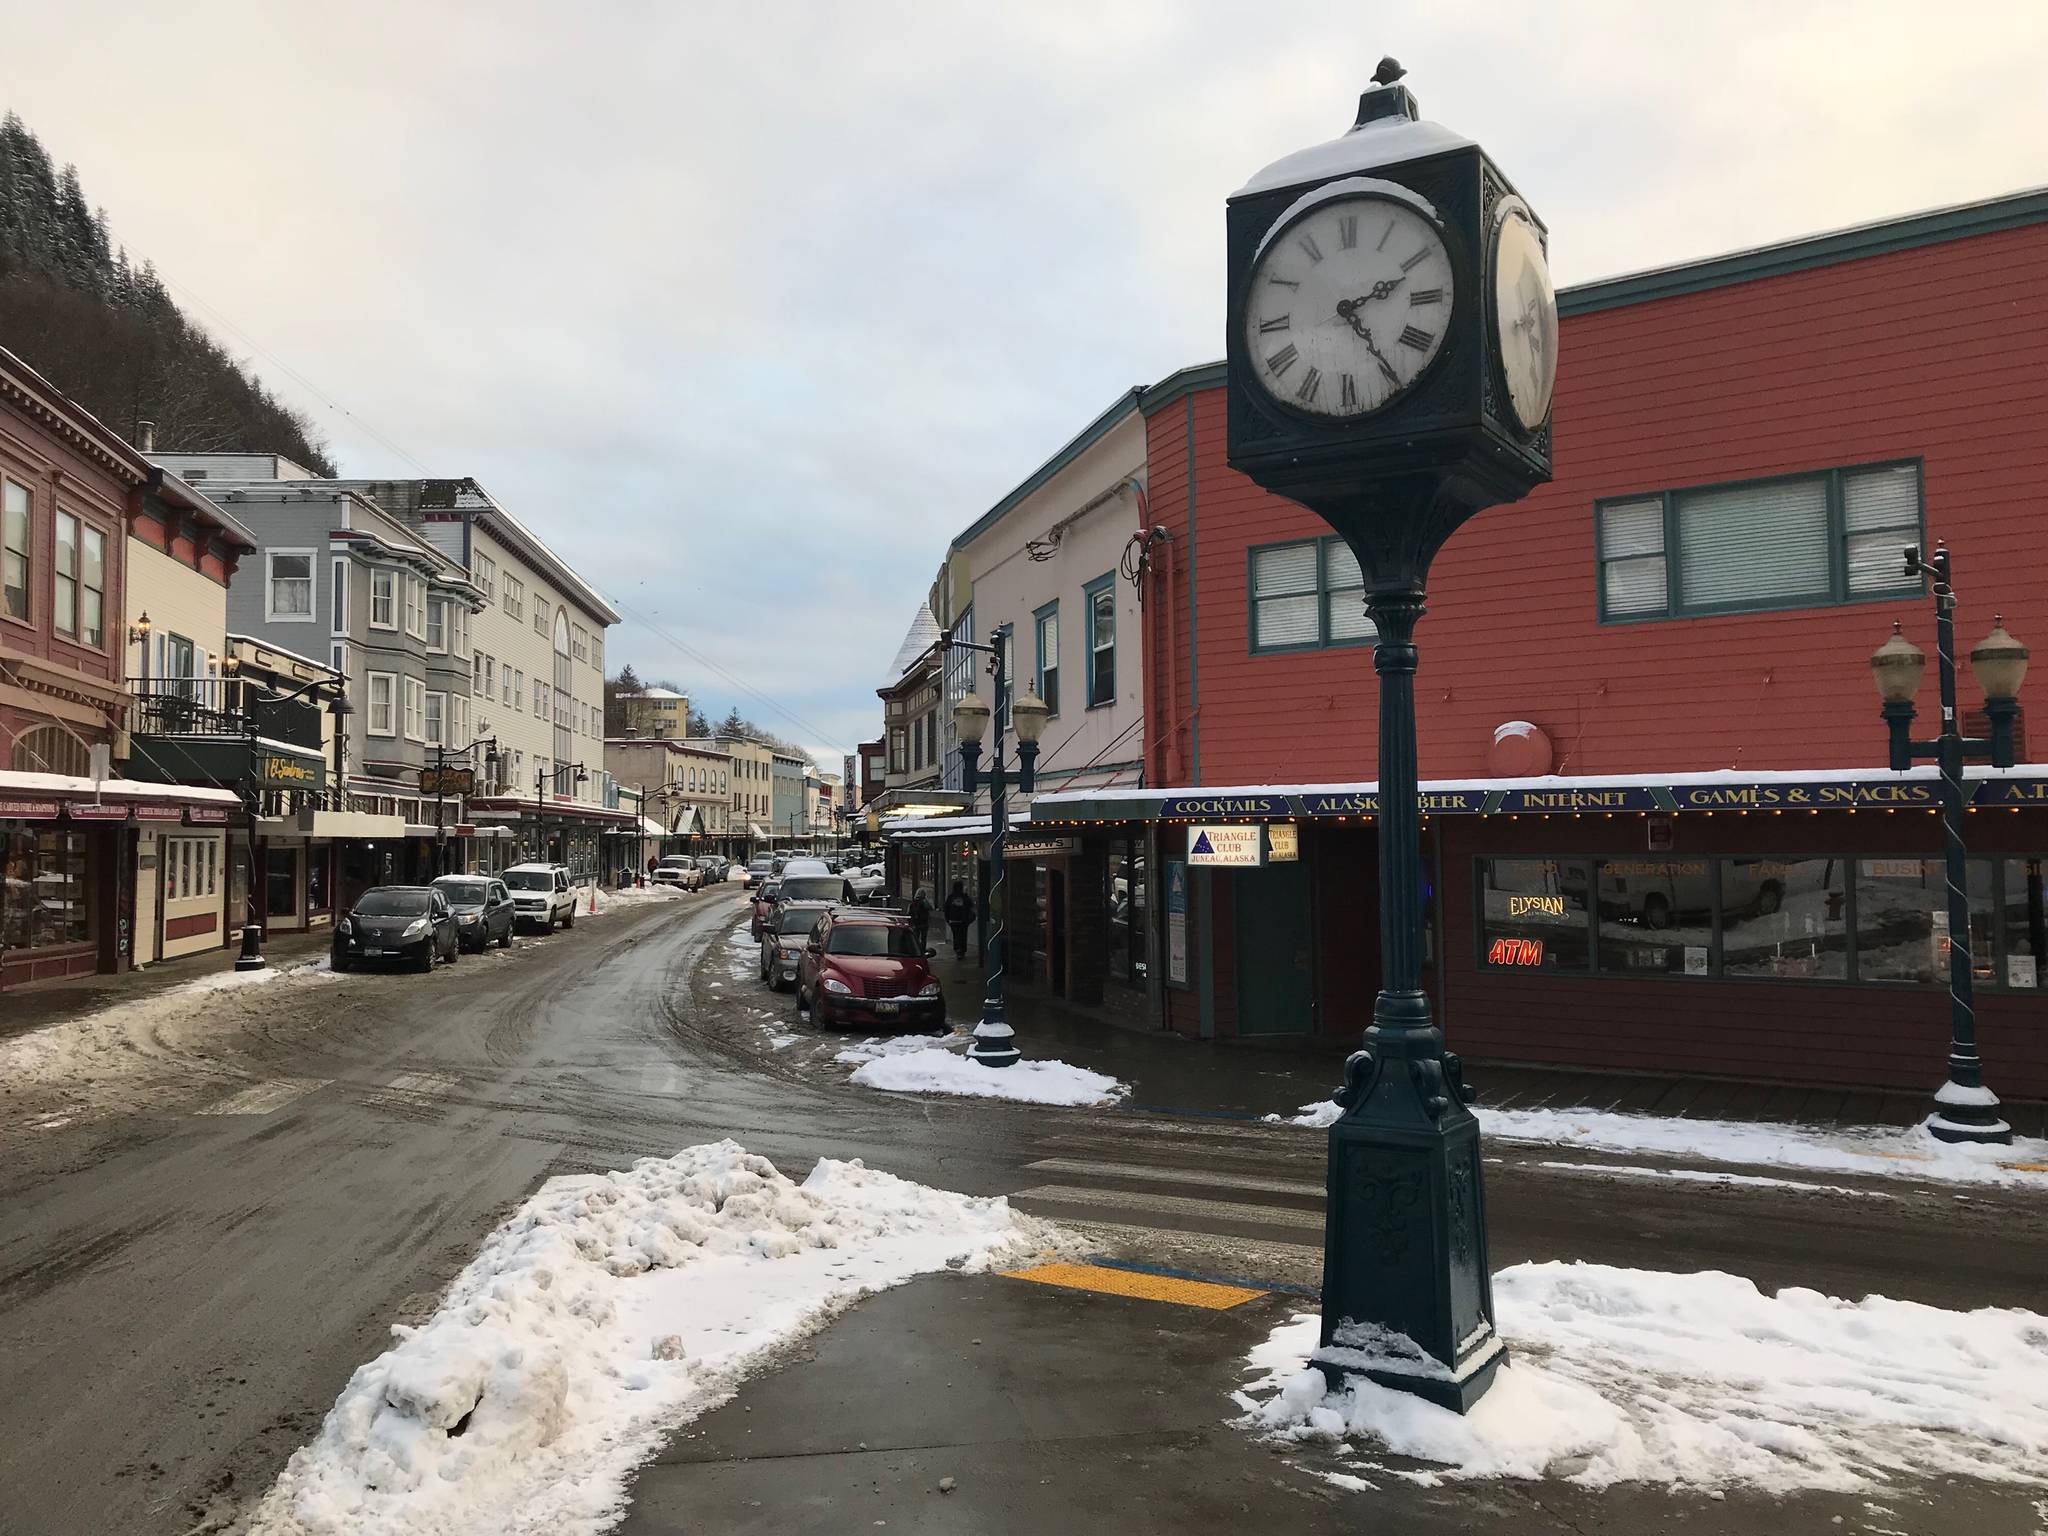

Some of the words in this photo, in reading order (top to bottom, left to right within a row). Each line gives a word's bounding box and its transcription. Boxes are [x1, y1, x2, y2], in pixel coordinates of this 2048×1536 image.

[1338, 216, 1358, 250] XII
[1299, 233, 1325, 265] XI
[1400, 246, 1433, 274] II
[1410, 288, 1443, 307] III
[1522, 792, 1627, 807] INTERNET
[1689, 787, 1780, 804] GAMES
[1787, 788, 1811, 803] &
[1819, 785, 1931, 803] SNACKS
[2003, 783, 2048, 800] A.T
[1175, 799, 1272, 813] COCKTAILS
[1316, 796, 1380, 811] ALASK
[1417, 795, 1468, 809] BEER
[1206, 831, 1257, 841] TRIANGLE
[1216, 843, 1242, 853] CLUB
[1274, 841, 1289, 850] CLUB
[1223, 855, 1256, 863] ALASKA
[1509, 896, 1564, 916] ELYSIAN
[1488, 938, 1544, 966] ATM
